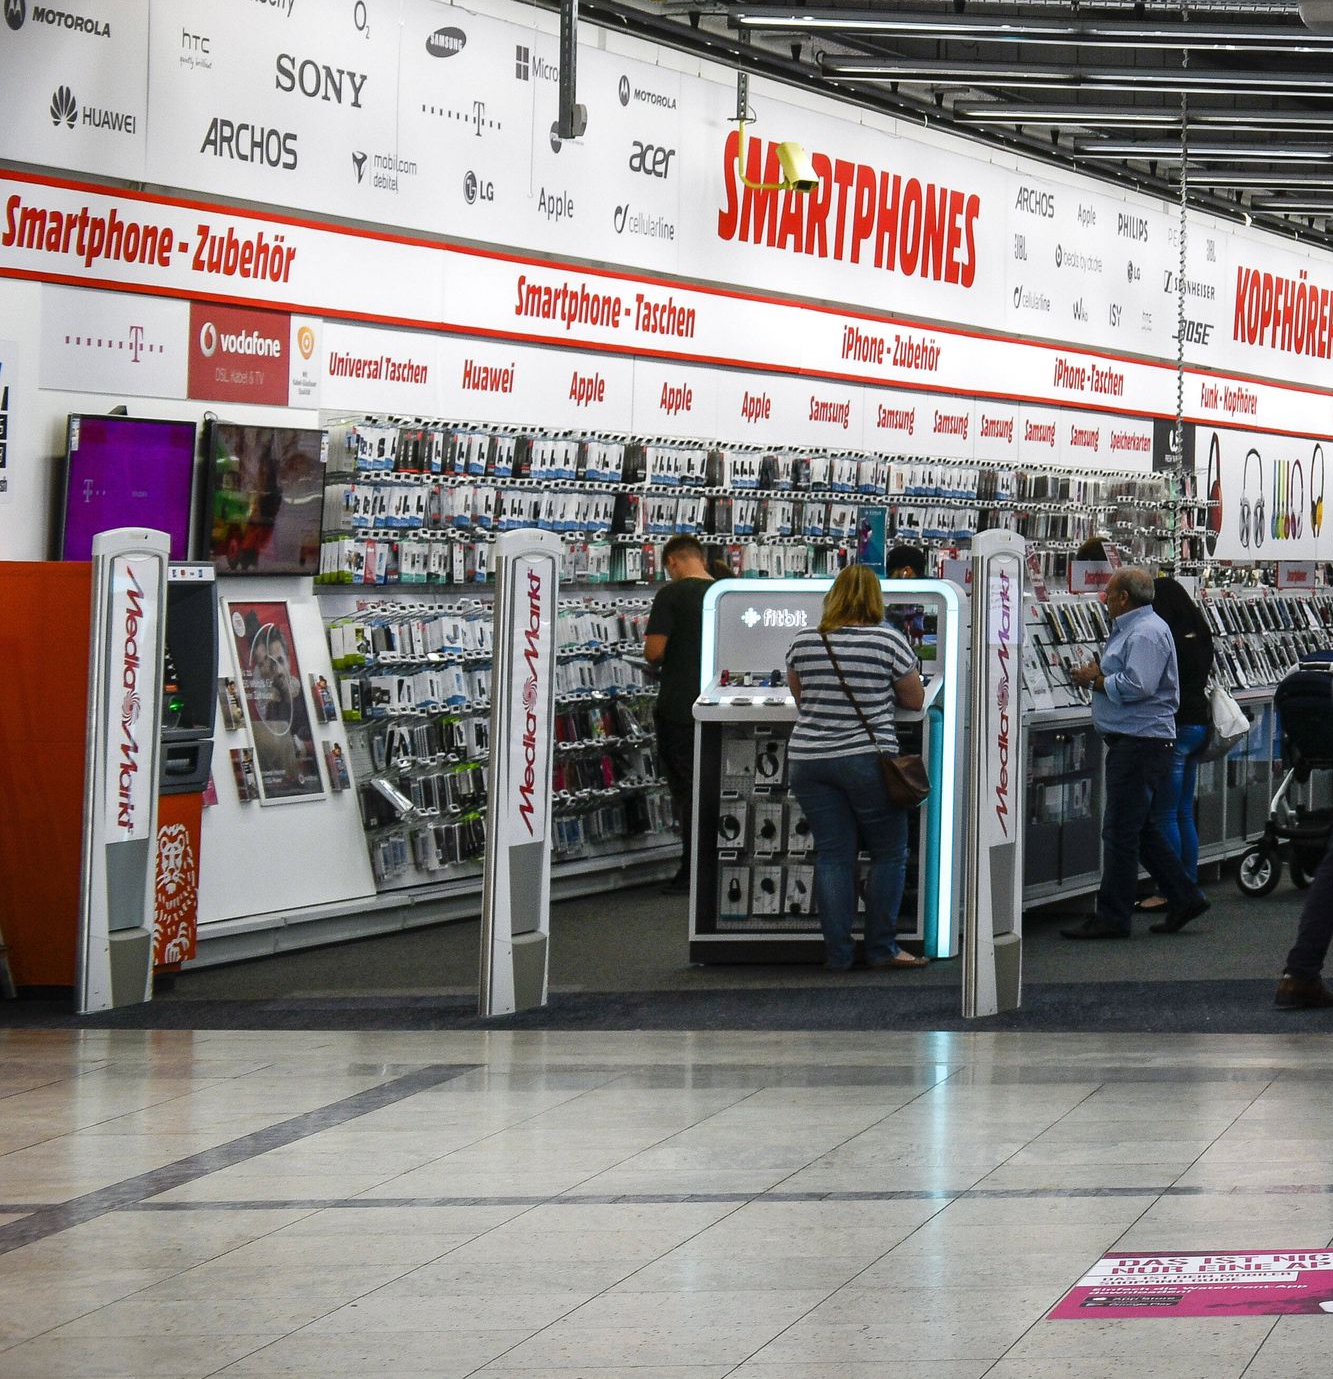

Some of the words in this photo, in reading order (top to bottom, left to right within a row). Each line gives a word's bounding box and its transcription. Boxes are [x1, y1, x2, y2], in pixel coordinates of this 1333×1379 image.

[32, 6, 111, 38] MOTOROLA
[275, 53, 367, 109] SONY
[634, 88, 677, 110] MOTOROLA
[82, 106, 136, 134] HUAWEI
[200, 117, 298, 170] ARCHOS
[629, 140, 675, 179] acer
[373, 174, 398, 192] debitel
[480, 181, 494, 201] LG
[538, 187, 574, 221] Apple
[717, 130, 981, 289] SMARTPHONES
[1015, 186, 1055, 218] ARCHOS
[1077, 204, 1096, 227] Apple
[1, 194, 173, 268] Smartphone
[192, 224, 297, 283] Zubehör
[629, 214, 675, 241] cellularline
[1118, 213, 1148, 242] PHILIPS
[1134, 267, 1141, 281] LG
[515, 275, 620, 330] Smartphone
[635, 294, 695, 338] Taschen
[1109, 303, 1122, 327] ISY
[220, 330, 280, 358] vodafone
[841, 325, 883, 365] iPhone
[892, 334, 940, 372] Zubehör
[329, 352, 383, 380] Universal
[384, 357, 428, 384] Taschen
[462, 359, 514, 393] Huawei
[569, 371, 604, 406] Apple
[660, 382, 692, 415] Apple
[741, 391, 771, 424] Apple
[809, 395, 850, 429] Samsung
[877, 404, 915, 436] Samsung
[933, 410, 969, 440] Samsung
[980, 414, 1014, 444] Samsung
[1025, 419, 1055, 448] Samsung
[1071, 424, 1100, 453] Samsung
[1110, 430, 1151, 453] Speicherkarten
[123, 565, 146, 689] Media
[524, 568, 541, 682] Markt
[763, 608, 807, 627] fitbit
[998, 571, 1011, 684] Markt
[117, 721, 140, 830] Markt
[519, 710, 537, 838] Media
[996, 712, 1009, 838] Media
[1112, 1266, 1183, 1274] NUR
[1199, 1262, 1273, 1272] EINE
[1119, 1258, 1189, 1266] DAS
[1204, 1255, 1260, 1264] IST
